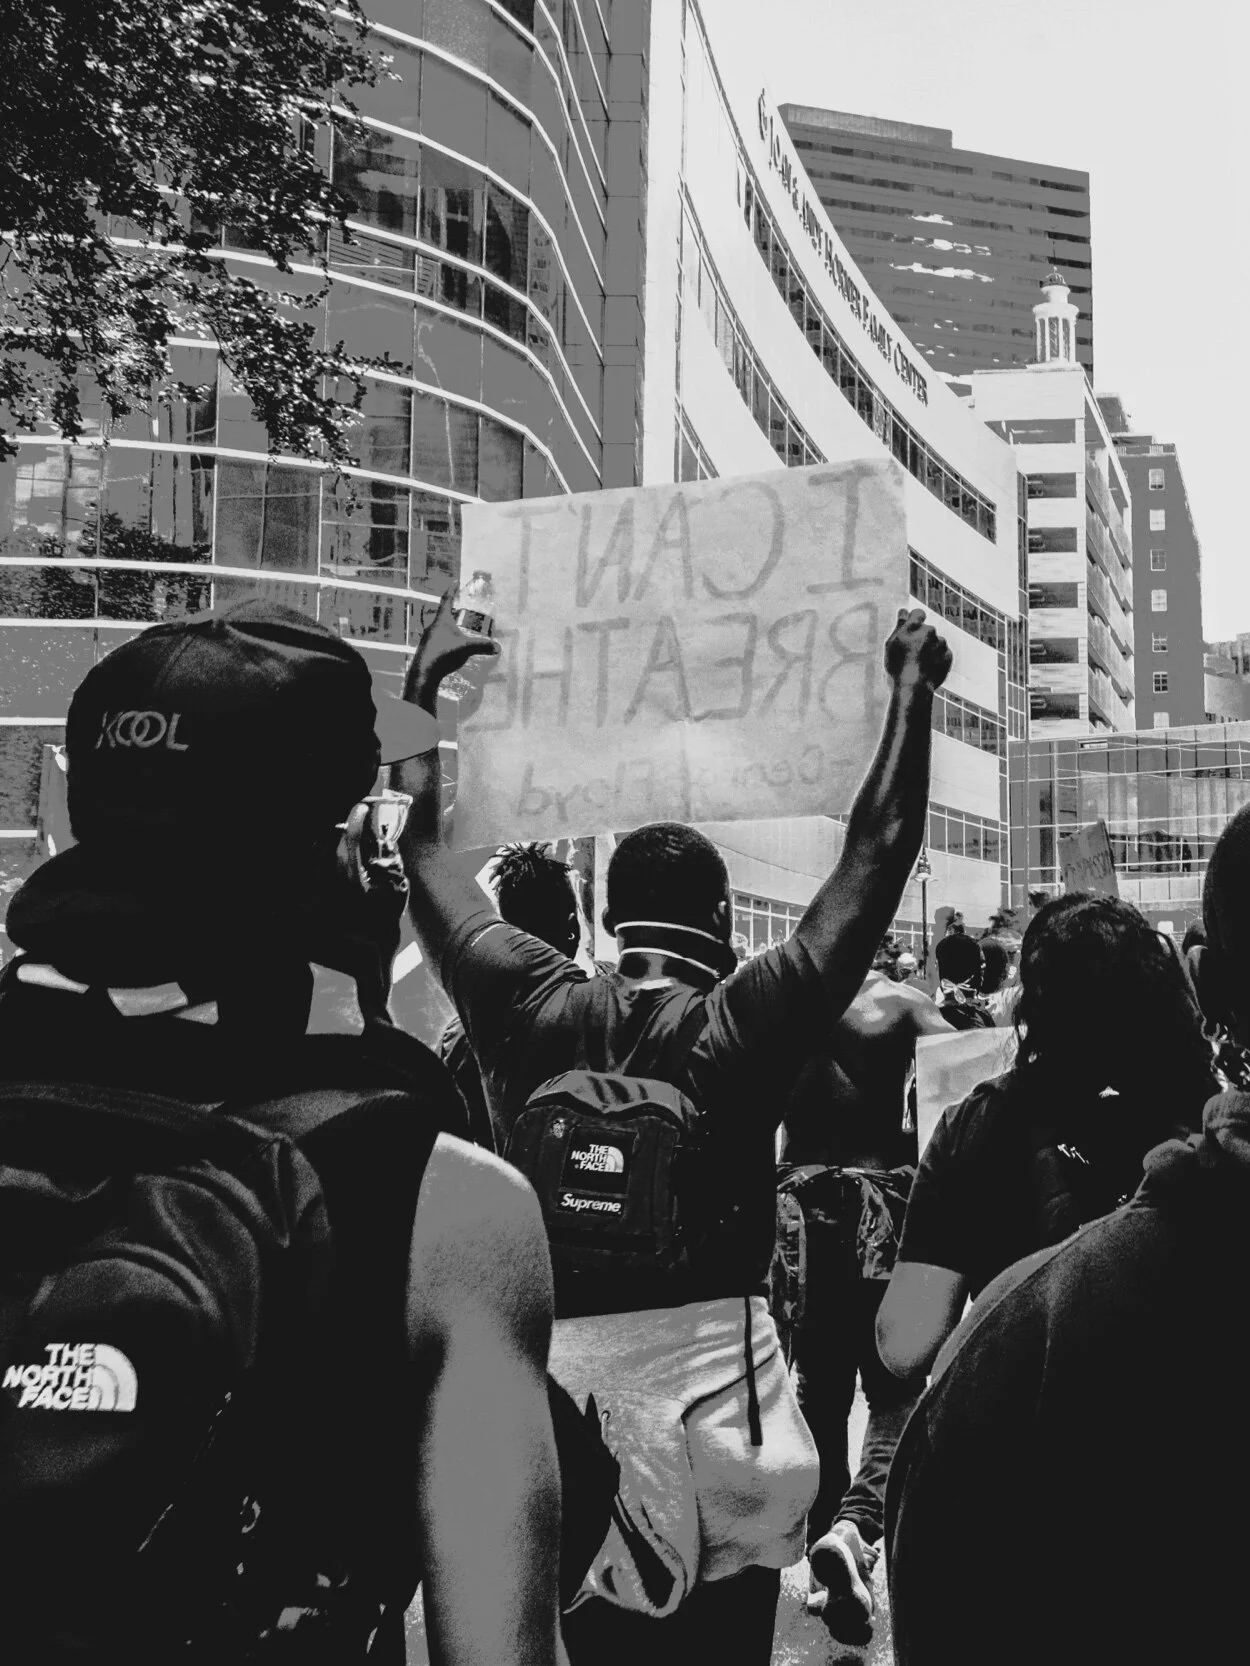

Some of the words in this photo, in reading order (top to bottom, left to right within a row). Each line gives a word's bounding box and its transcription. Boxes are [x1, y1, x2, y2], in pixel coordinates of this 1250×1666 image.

[862, 294, 892, 363] FAMILY
[894, 342, 928, 408] CENTER
[94, 710, 189, 751] KOOL
[571, 1150, 607, 1163] NORTH
[588, 1143, 609, 1155] THE
[579, 1161, 605, 1172] FACE
[560, 1193, 622, 1212] Supreme
[44, 1342, 96, 1367] THE
[1, 1364, 93, 1389] NORTH
[17, 1385, 92, 1411] FACE
